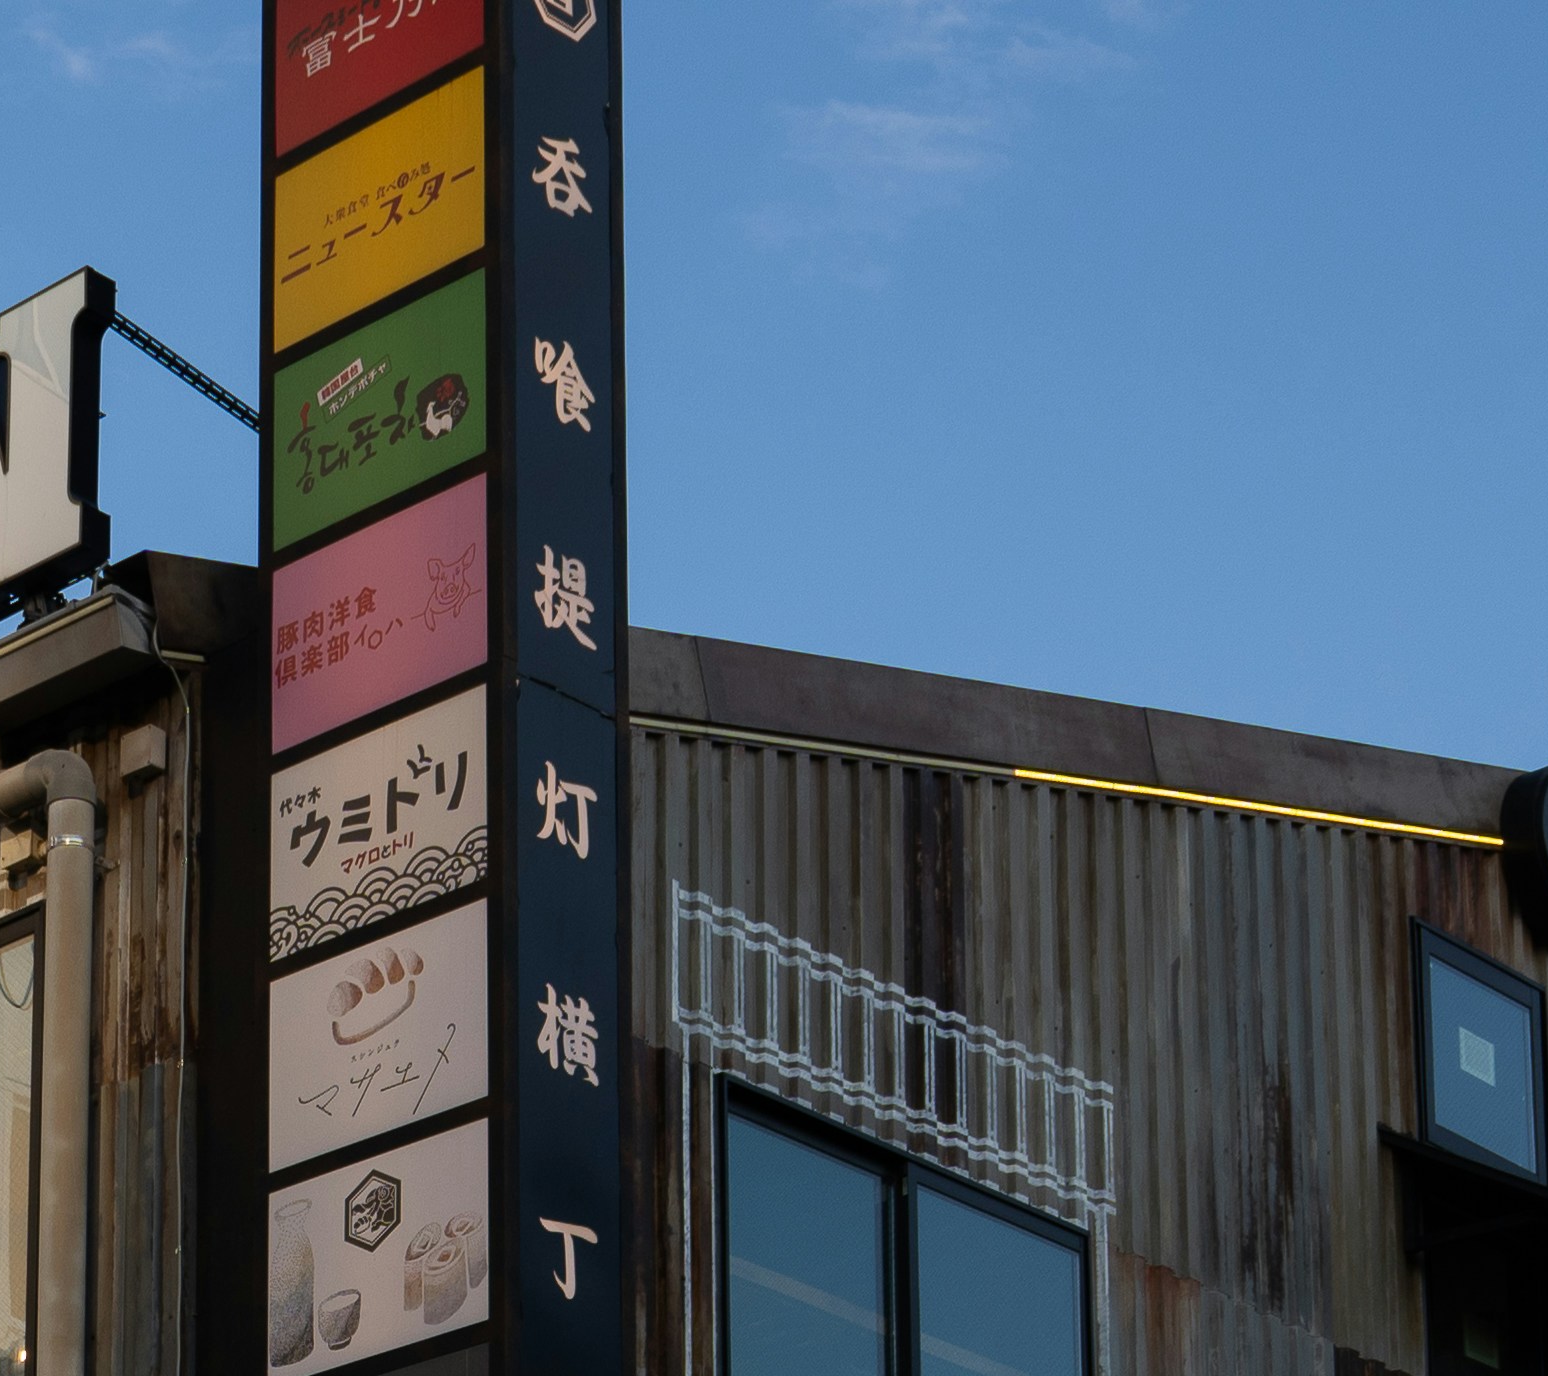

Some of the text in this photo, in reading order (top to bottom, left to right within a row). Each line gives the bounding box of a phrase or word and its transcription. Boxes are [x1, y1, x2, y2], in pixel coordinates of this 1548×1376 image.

[281, 166, 476, 284] ニュースター
[275, 617, 403, 689] 倶楽部 イロハ
[277, 586, 377, 654] 豚肉洋食
[279, 787, 321, 818] 代々木
[290, 745, 468, 868] ウミドリ
[341, 831, 414, 874] マグロとトリ
